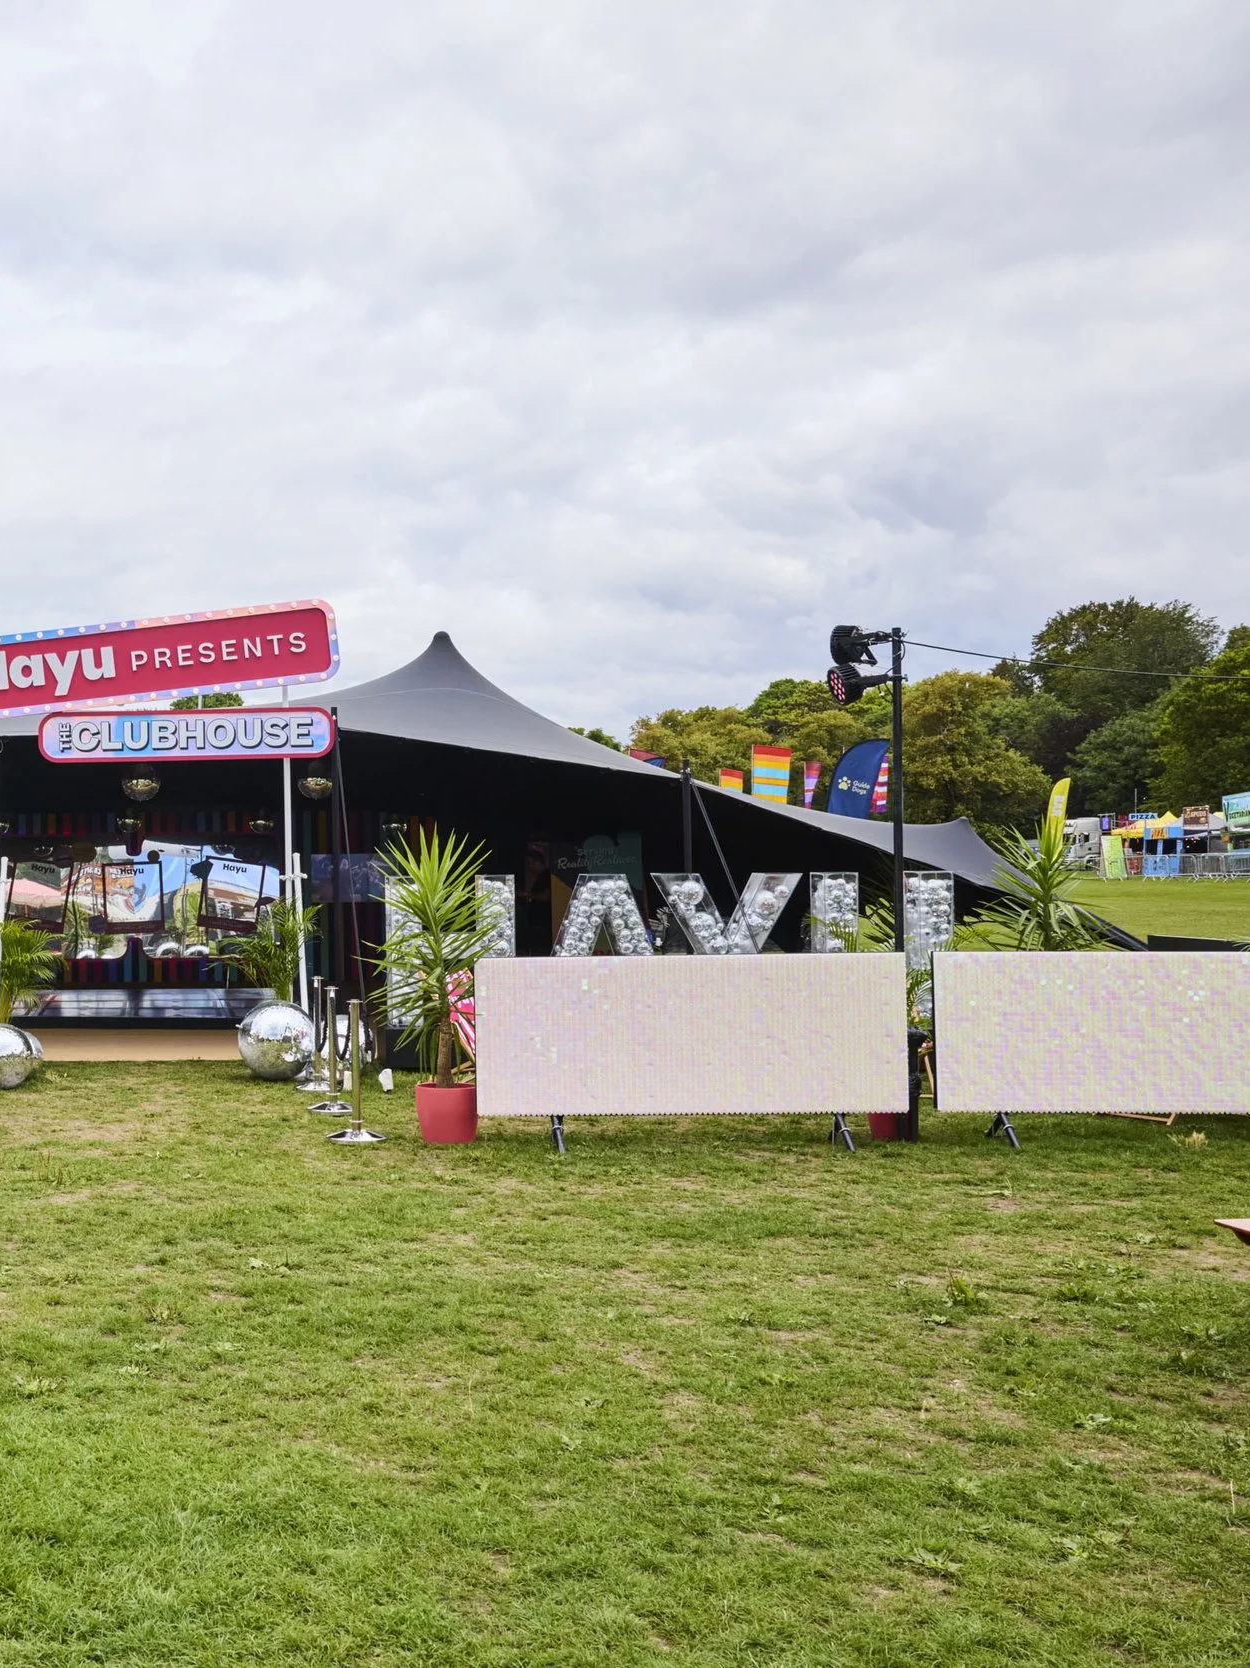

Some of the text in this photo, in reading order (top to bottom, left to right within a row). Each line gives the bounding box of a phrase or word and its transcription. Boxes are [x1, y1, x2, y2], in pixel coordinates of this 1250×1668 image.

[130, 631, 308, 672] PRESENTS
[58, 716, 316, 754] THE CLUBHOUSE
[852, 786, 866, 795] Dogs
[853, 780, 870, 789] Guide
[30, 862, 56, 875] Hayu
[120, 865, 145, 877] Hayu
[222, 862, 248, 874] Hayu
